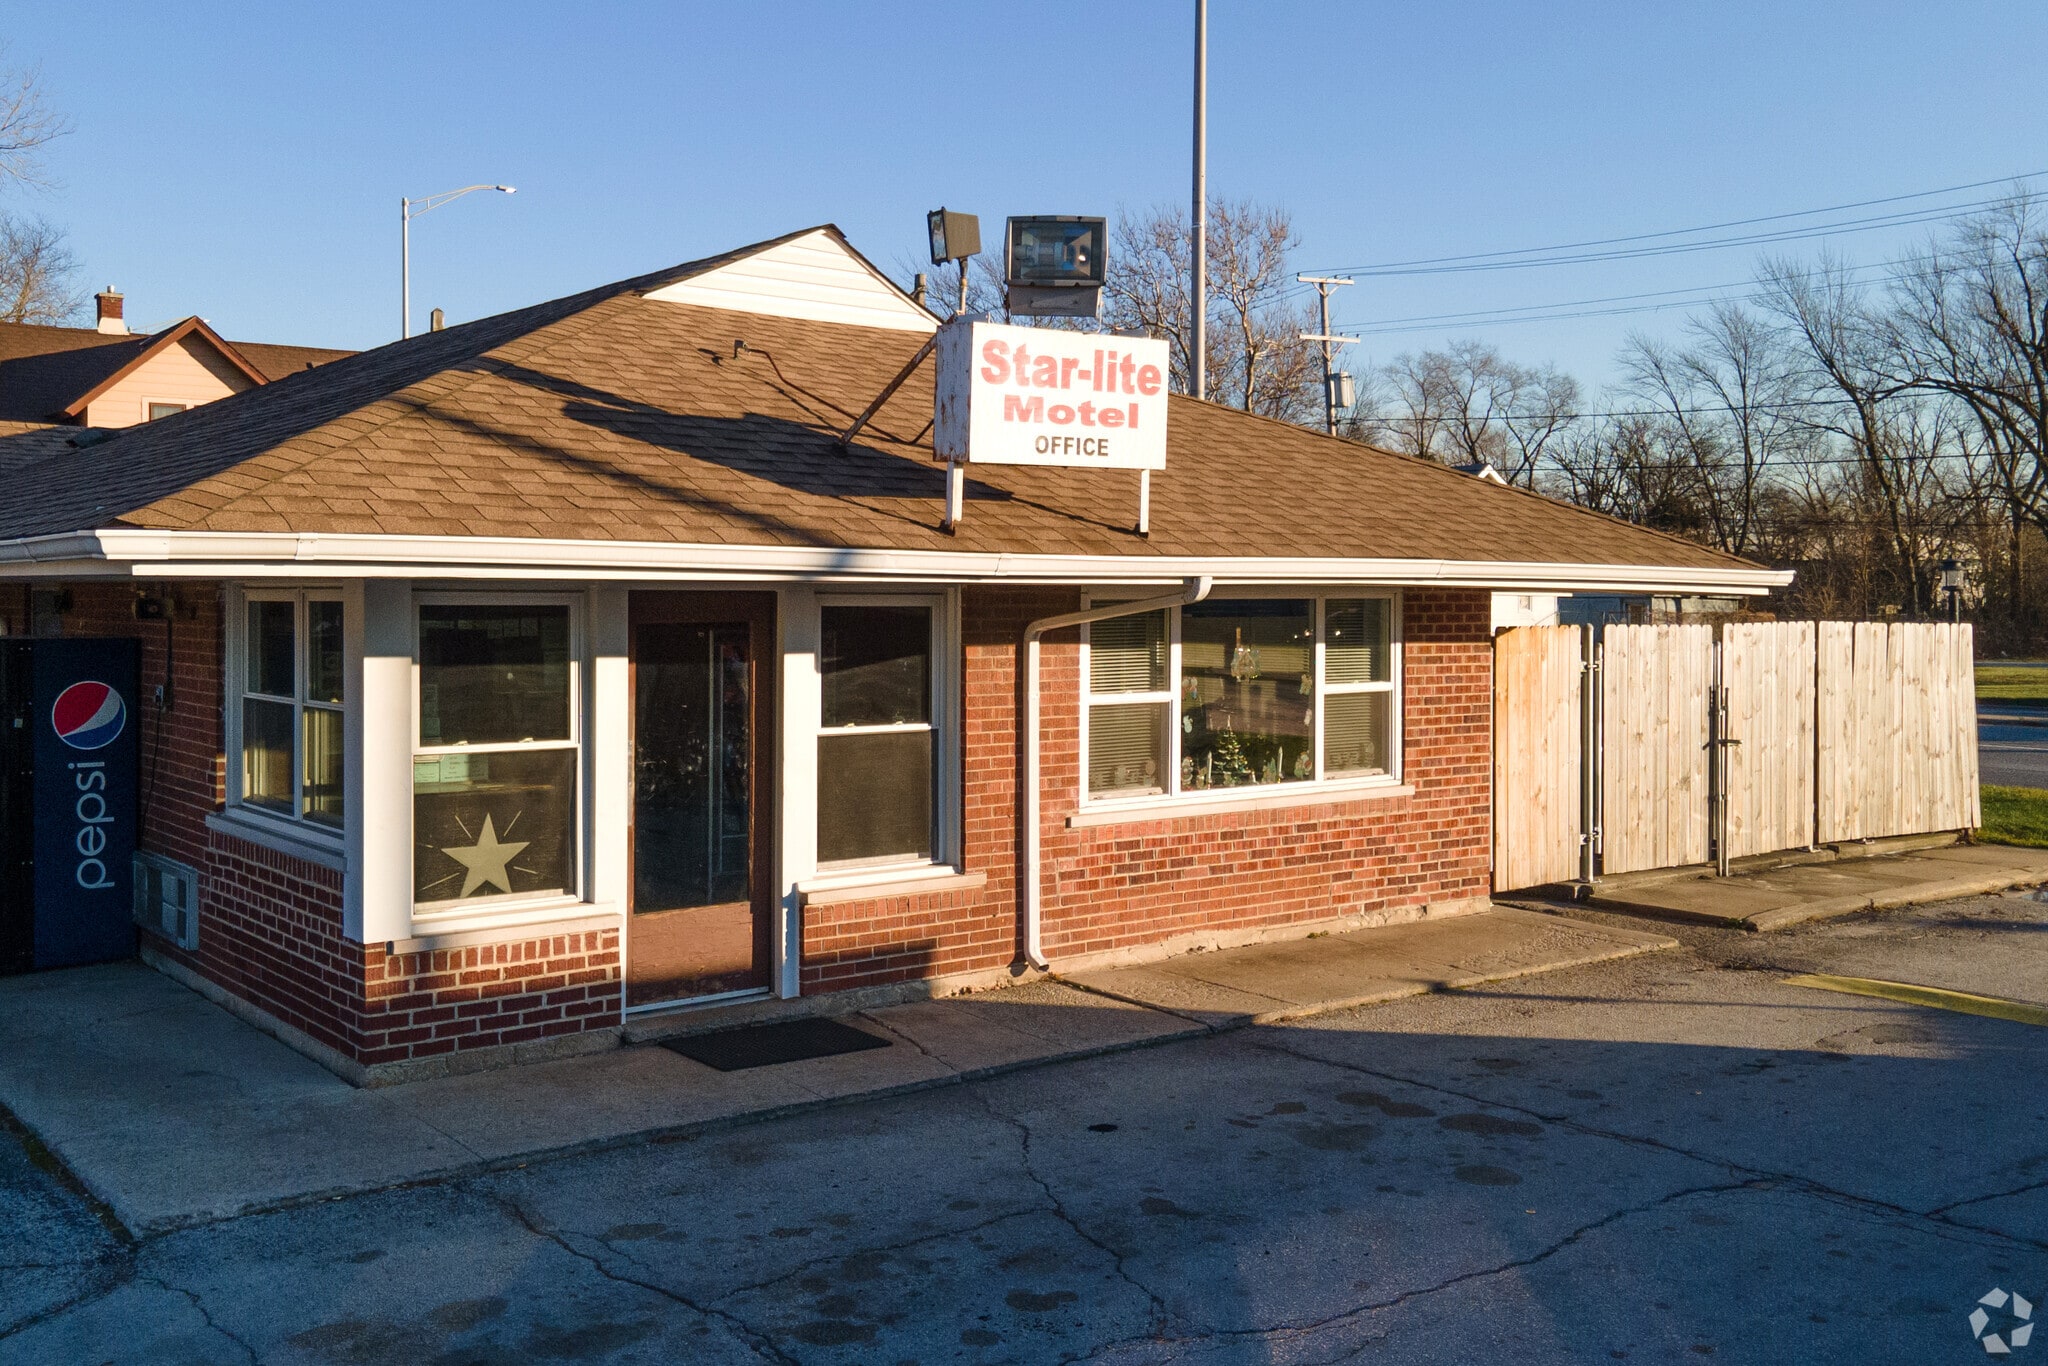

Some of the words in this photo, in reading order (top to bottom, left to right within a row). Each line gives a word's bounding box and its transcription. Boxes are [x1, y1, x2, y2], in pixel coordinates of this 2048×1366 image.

[980, 339, 1162, 396] Star-lite
[1003, 394, 1139, 429] Motel
[1034, 435, 1109, 457] OFFICE
[68, 761, 115, 889] pepsi
